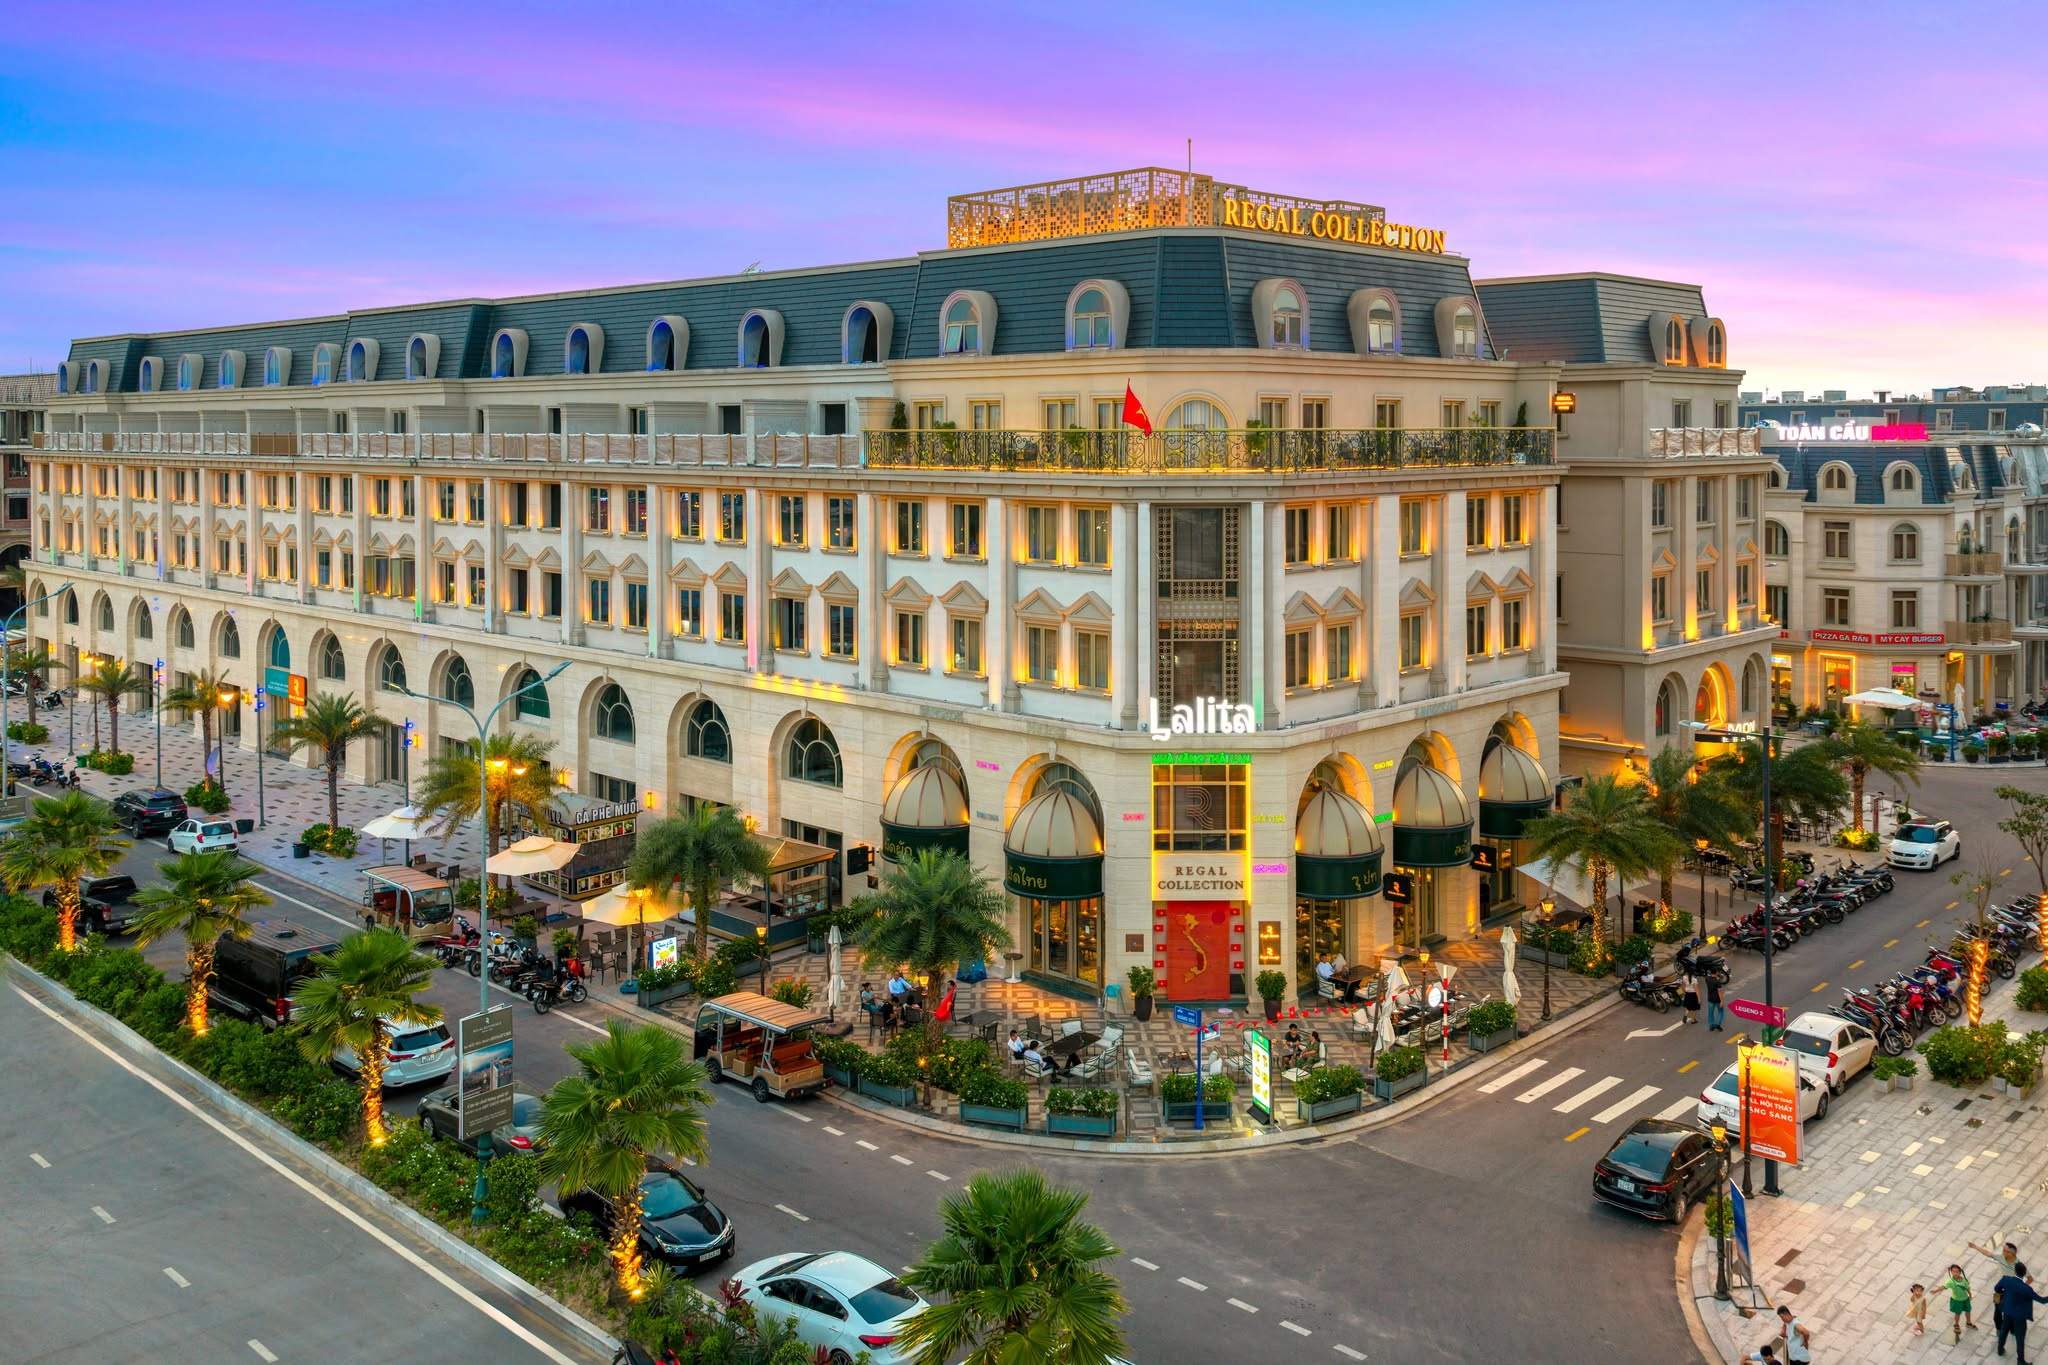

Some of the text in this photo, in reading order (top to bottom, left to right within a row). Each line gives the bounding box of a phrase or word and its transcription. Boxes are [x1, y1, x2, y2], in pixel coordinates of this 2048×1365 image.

[1223, 198, 1446, 254] REGAL COLLECTION
[1150, 696, 1255, 741] Lalita
[592, 804, 611, 819] PHÊ
[1175, 866, 1227, 876] REGAL
[1157, 880, 1244, 890] COLLECTION
[1735, 1006, 1759, 1015] LEGEND
